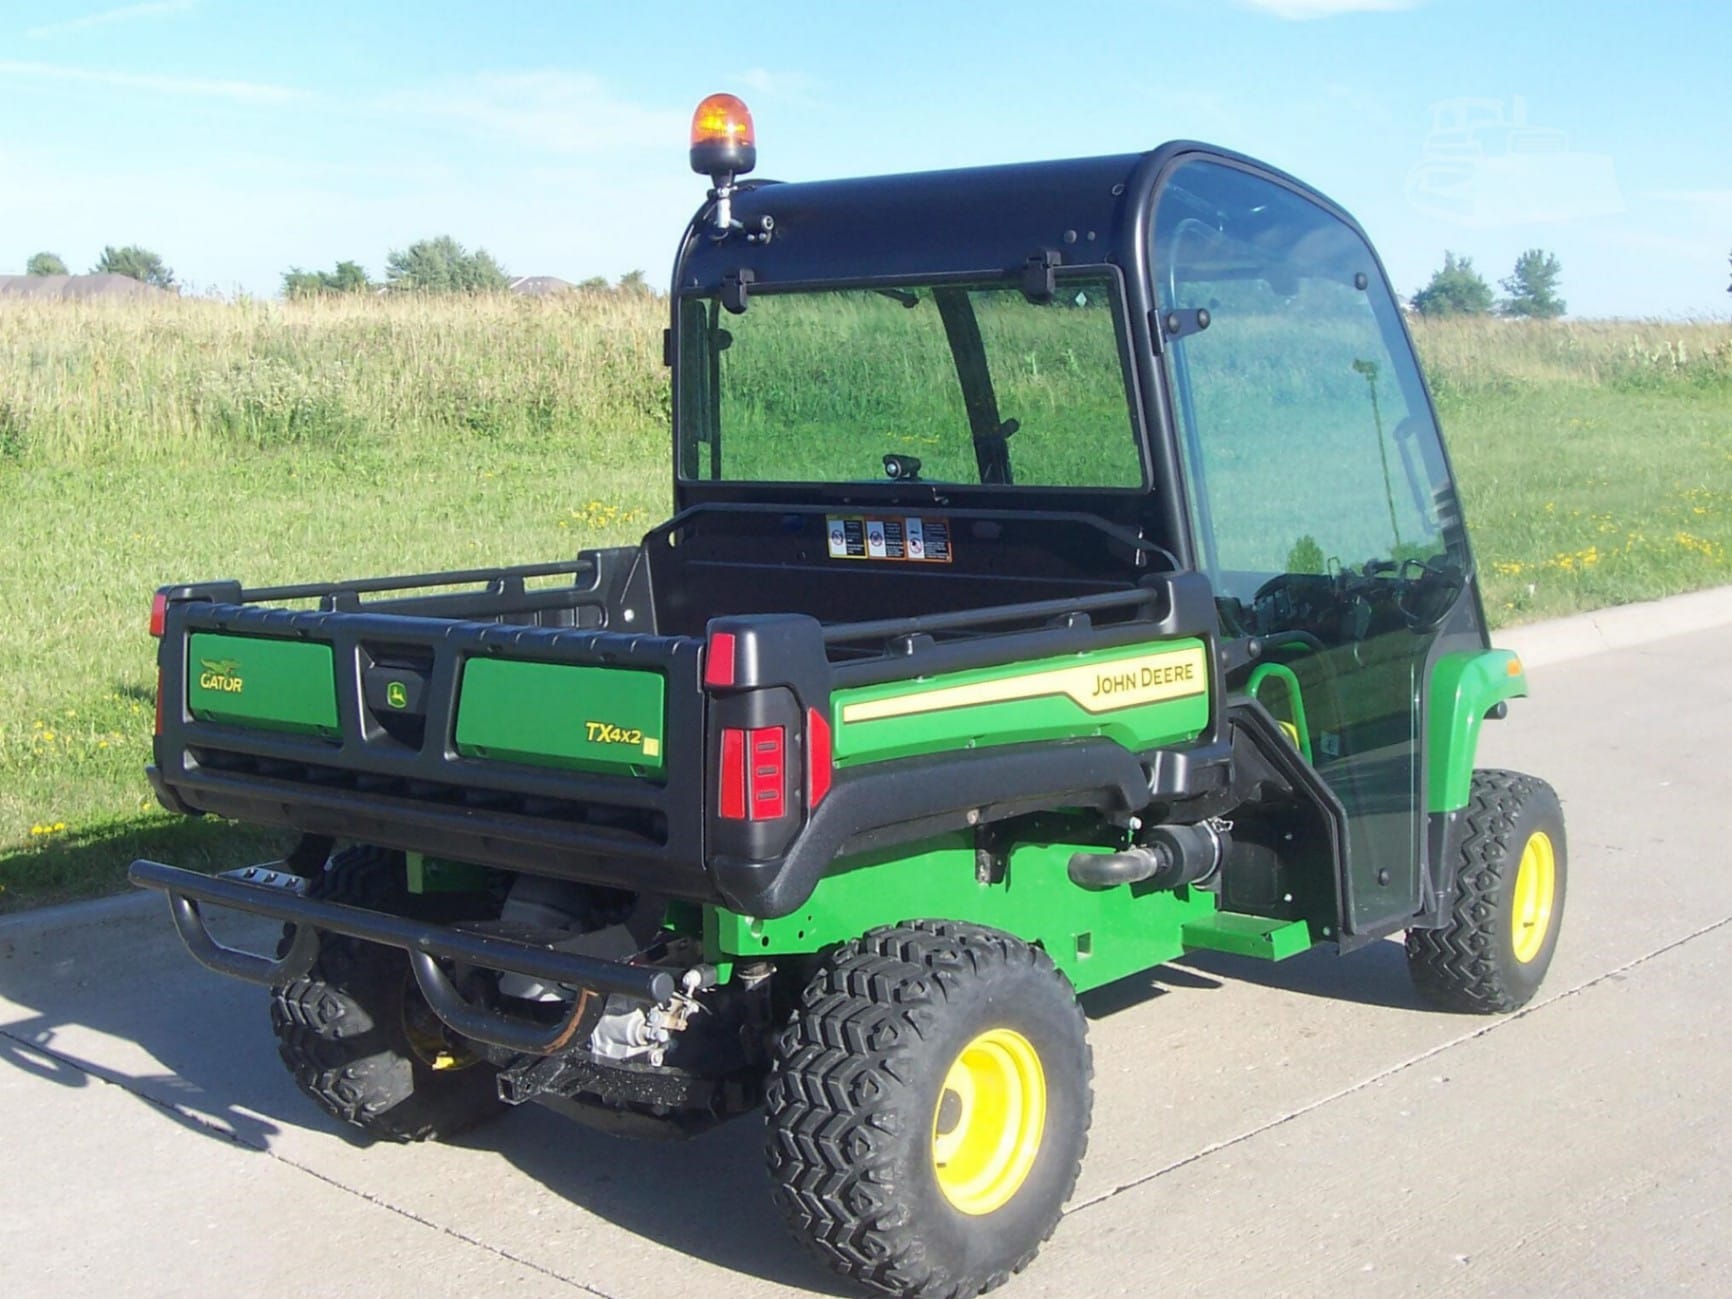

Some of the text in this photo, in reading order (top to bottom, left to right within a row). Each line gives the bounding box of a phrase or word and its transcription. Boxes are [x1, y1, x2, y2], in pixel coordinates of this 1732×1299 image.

[200, 673, 243, 693] GATOR
[1092, 663, 1194, 697] JOHN DEERE
